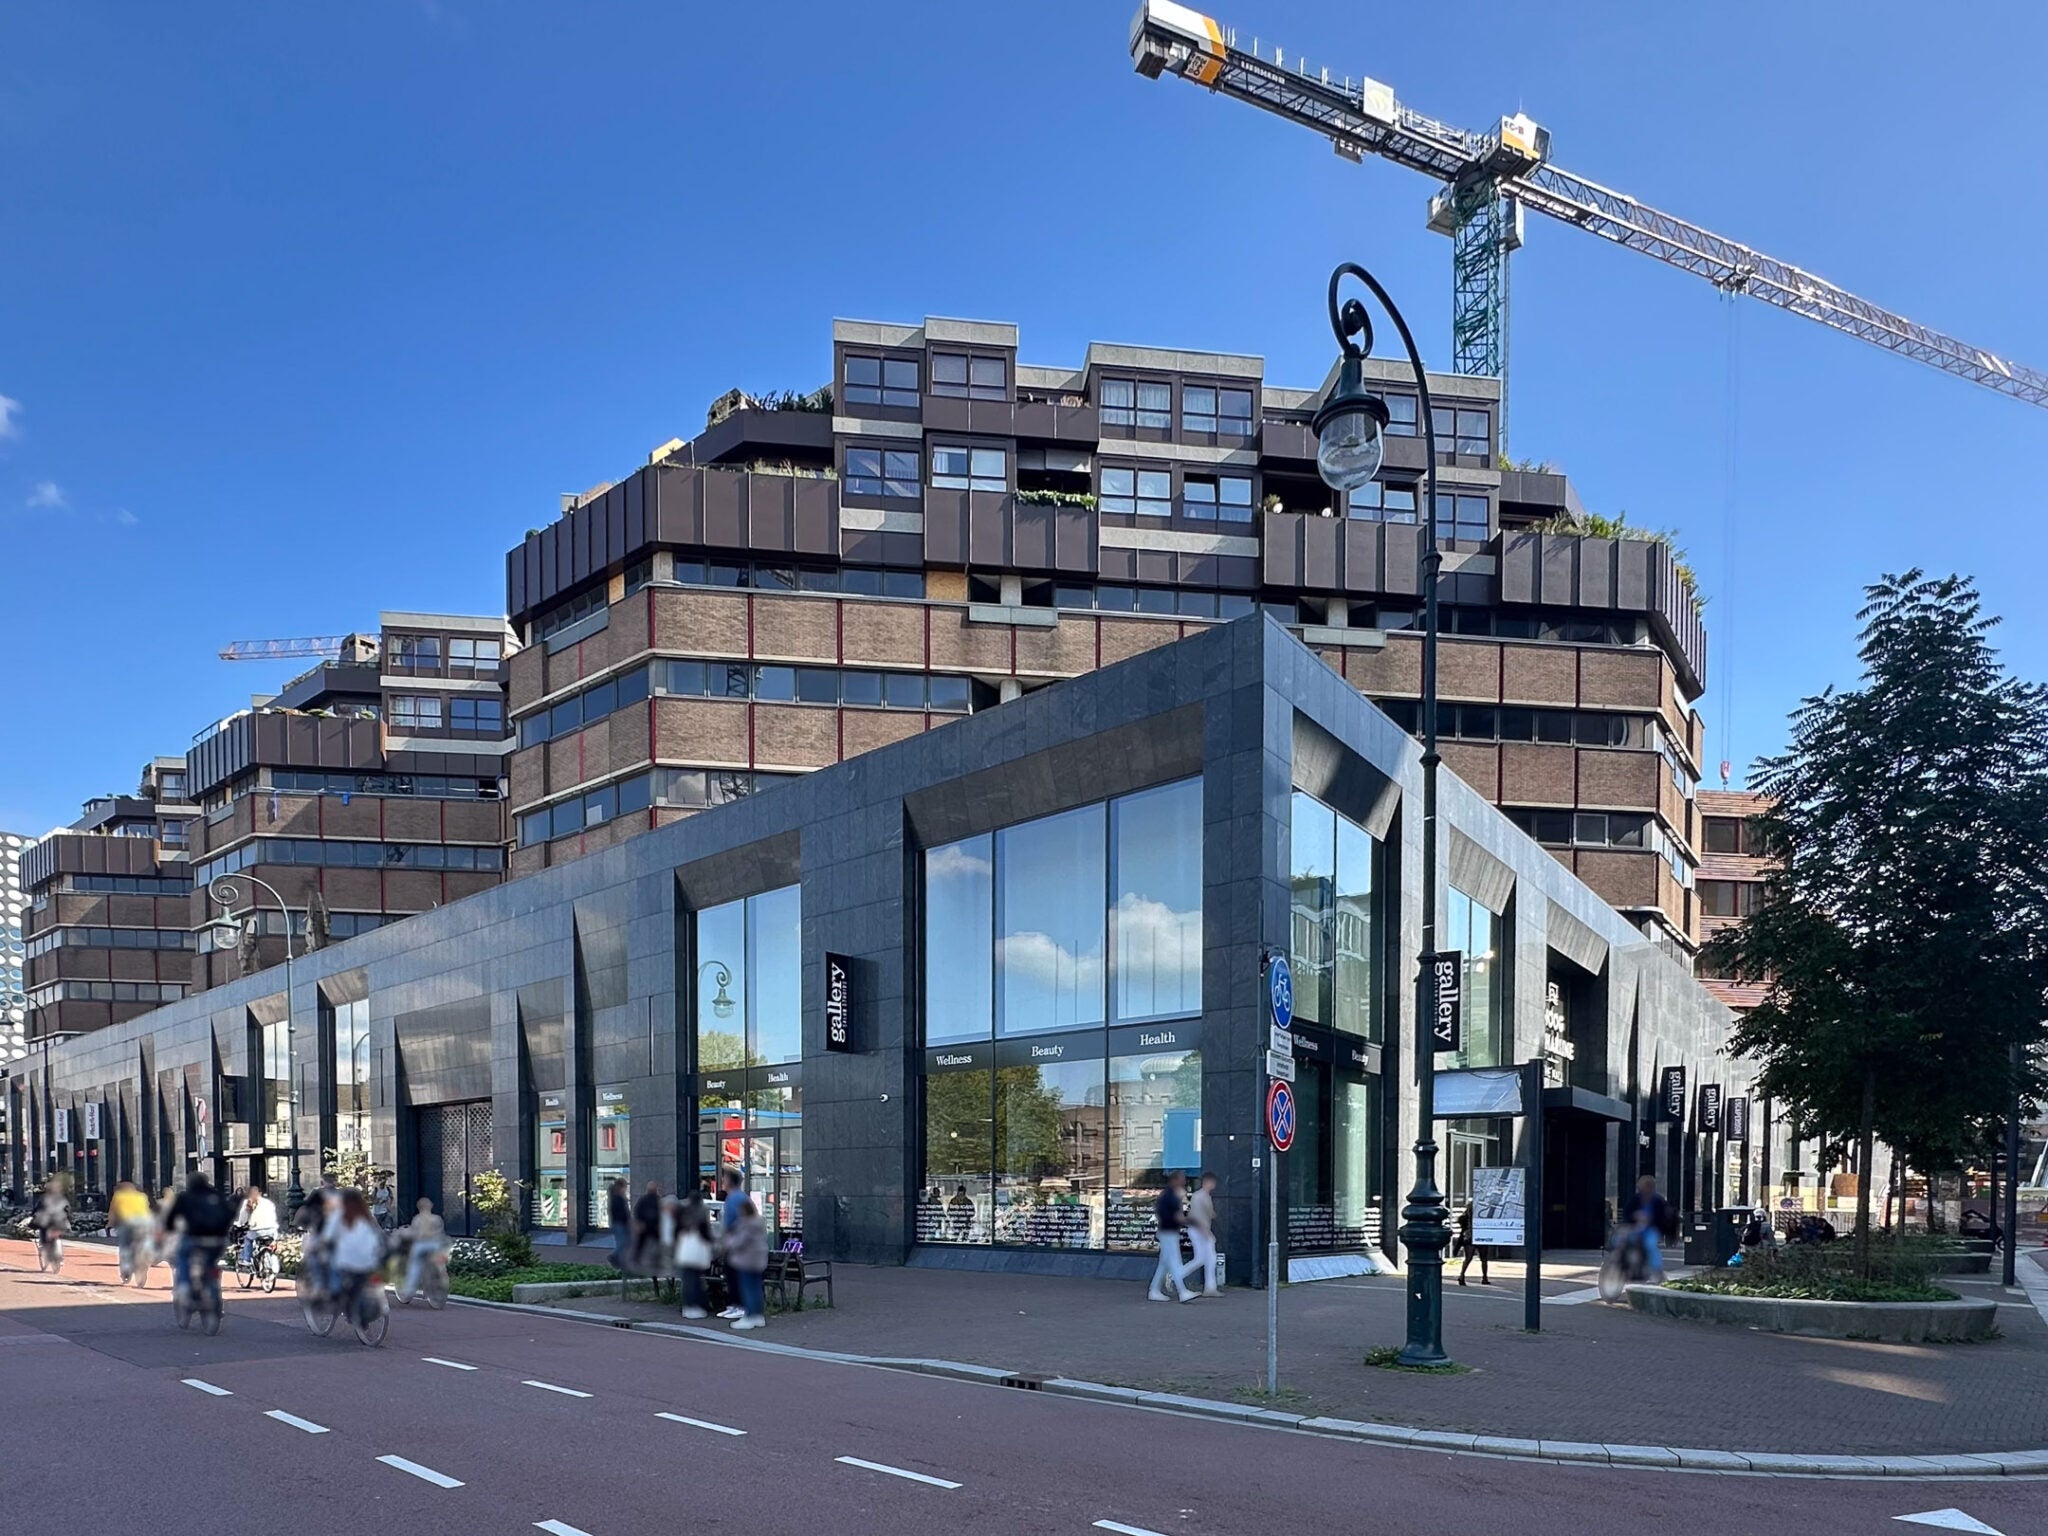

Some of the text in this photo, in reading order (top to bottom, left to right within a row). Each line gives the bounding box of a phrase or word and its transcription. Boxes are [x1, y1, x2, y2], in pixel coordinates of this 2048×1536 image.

[827, 962, 846, 1043] gallery
[1434, 961, 1459, 1042] gallery
[936, 1032, 1176, 1066] Wellness Beauty Health
[1293, 1033, 1318, 1051] Wellness
[706, 1072, 789, 1089] Beauty Health
[1669, 1071, 1684, 1117] gallery
[1705, 1088, 1719, 1128] gallery
